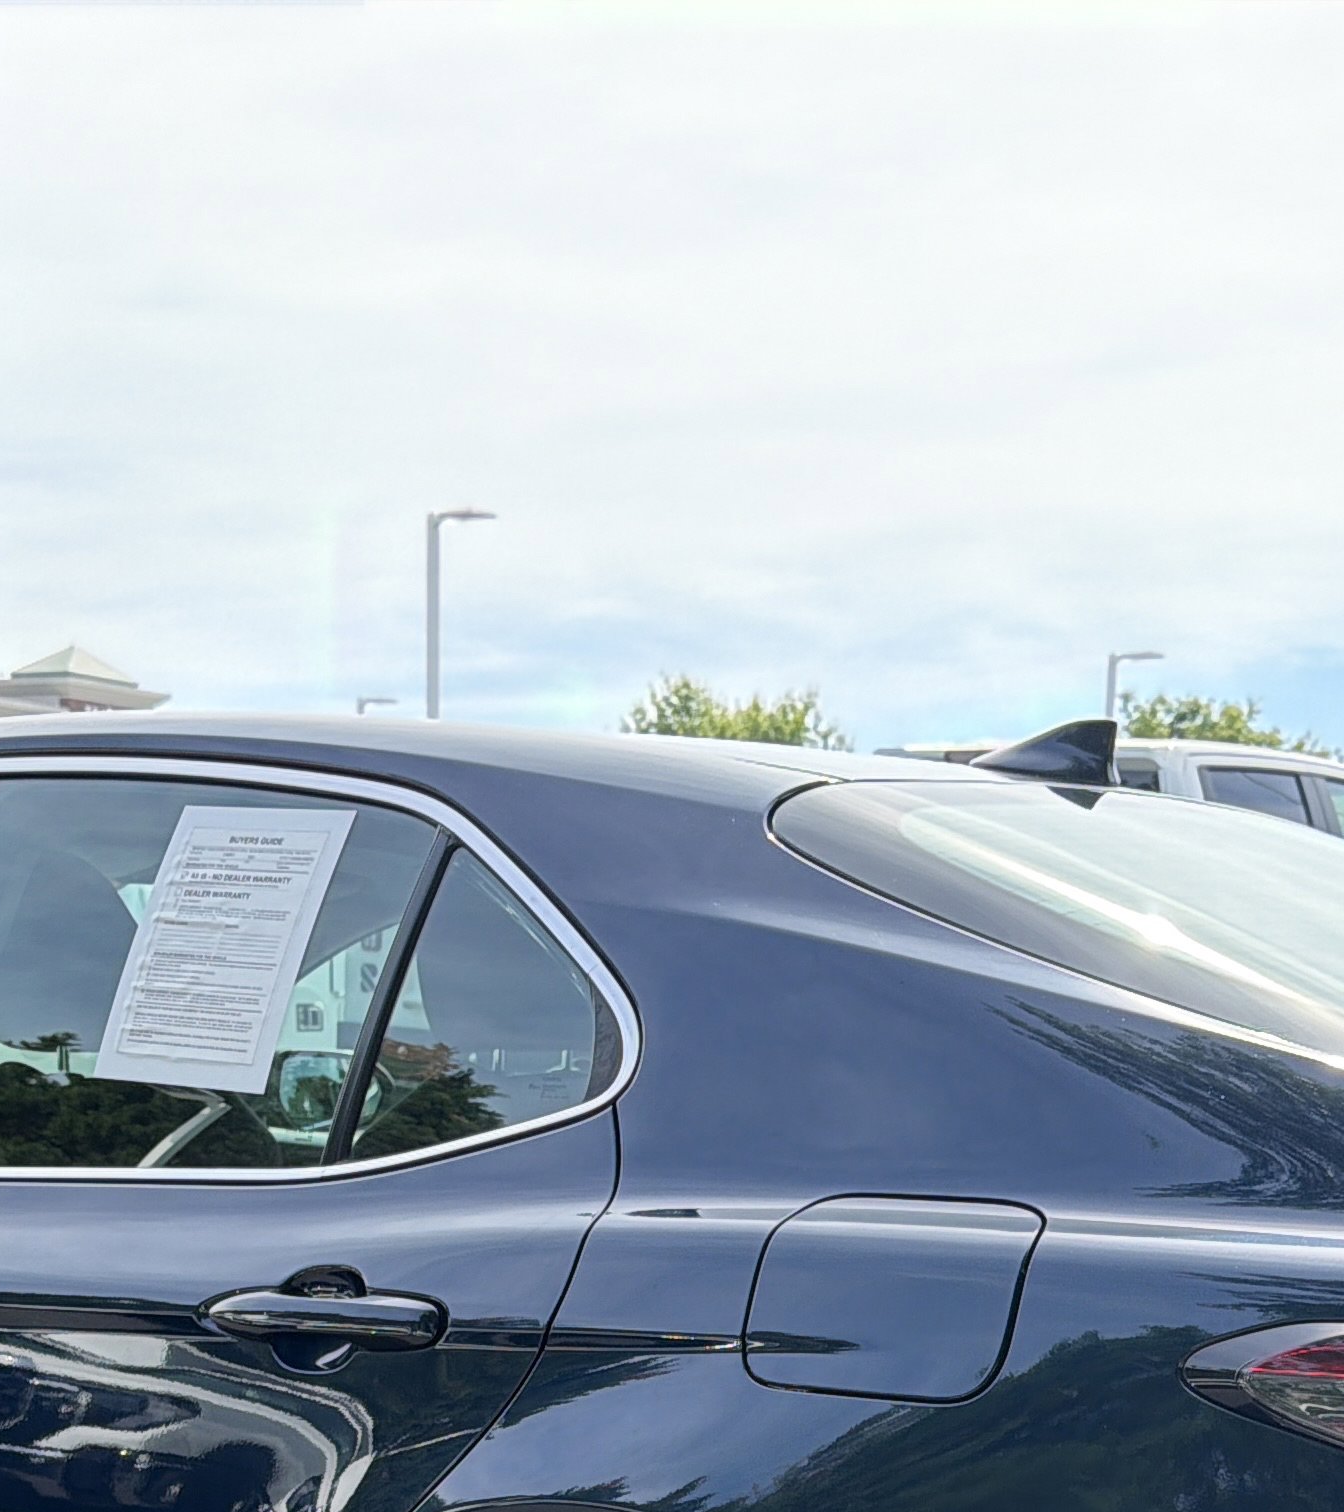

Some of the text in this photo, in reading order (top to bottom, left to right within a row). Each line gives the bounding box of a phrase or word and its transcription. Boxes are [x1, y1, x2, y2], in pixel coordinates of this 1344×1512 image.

[228, 836, 284, 846] BUYERS GUIDE
[212, 872, 223, 881] NO
[224, 873, 251, 882] DEALER
[252, 875, 292, 885] WARRANTY
[183, 888, 251, 900] DEALER WARRANTY
